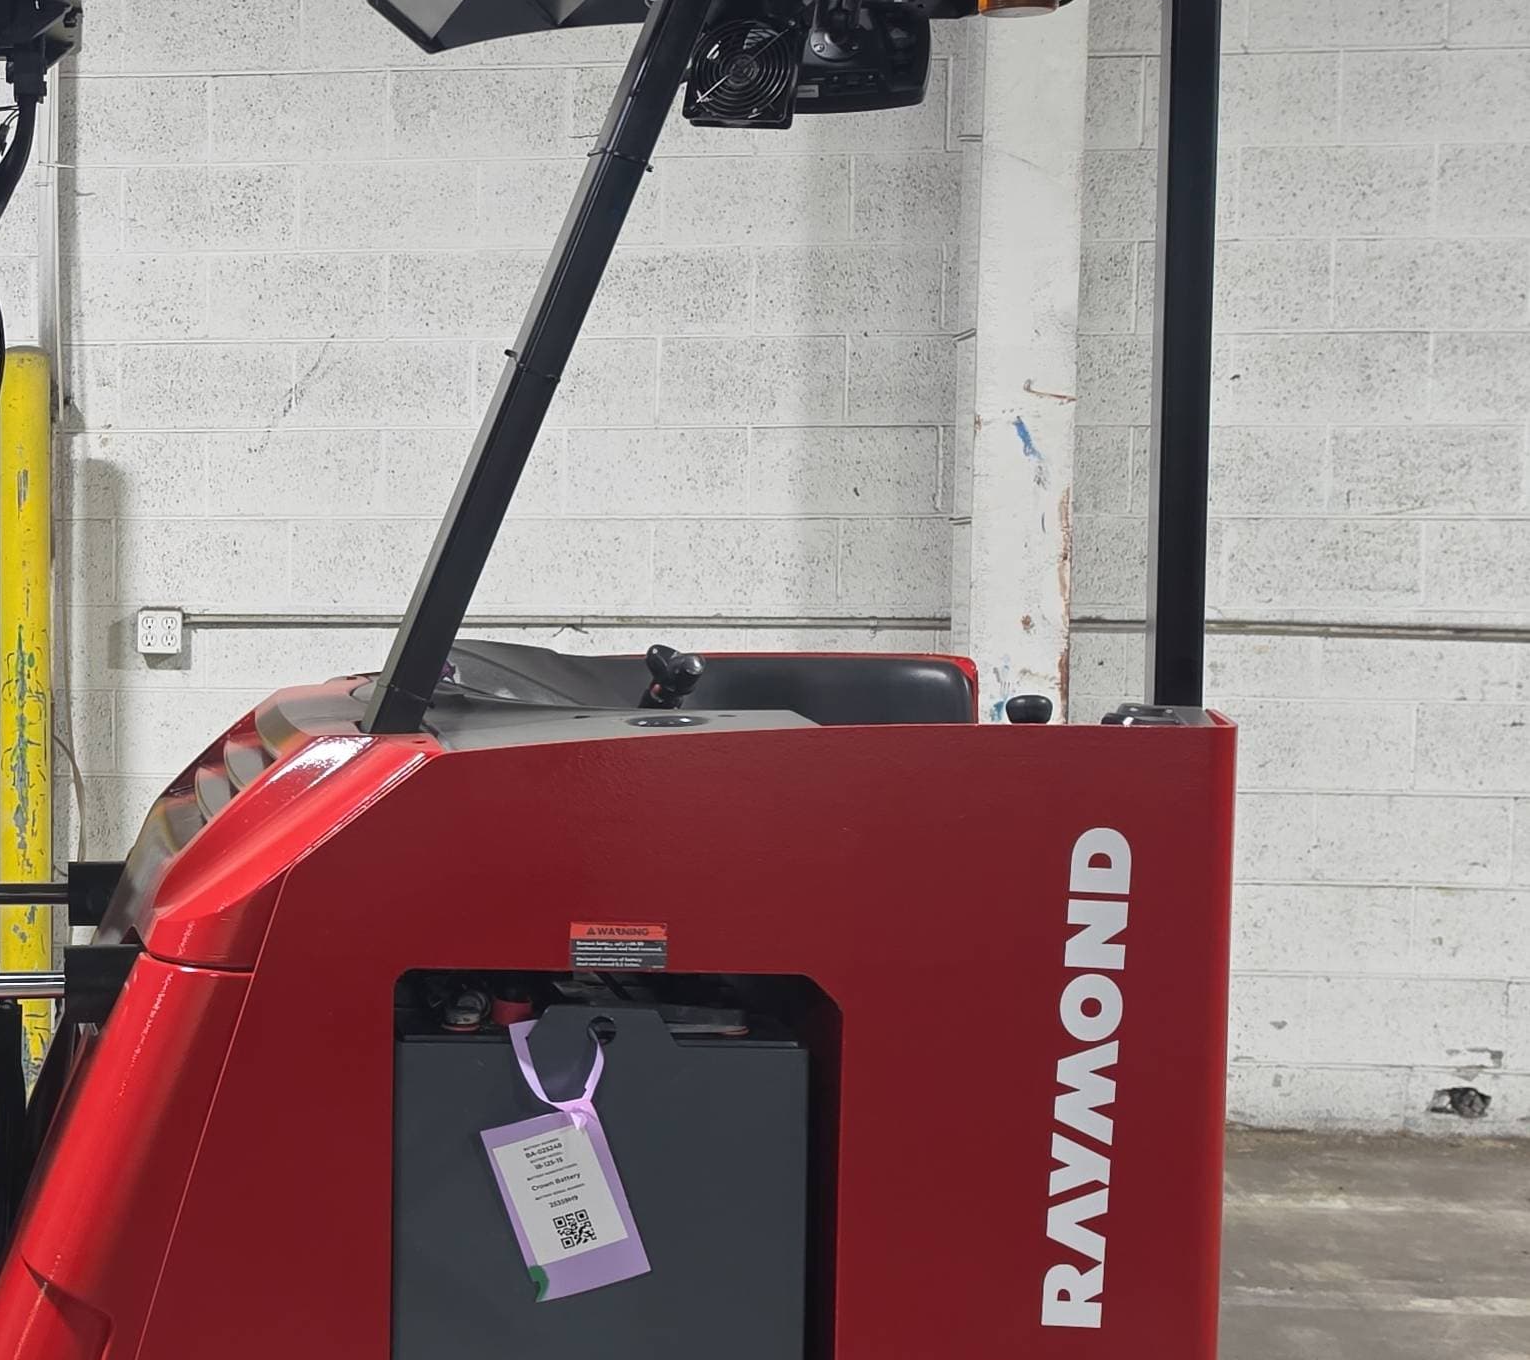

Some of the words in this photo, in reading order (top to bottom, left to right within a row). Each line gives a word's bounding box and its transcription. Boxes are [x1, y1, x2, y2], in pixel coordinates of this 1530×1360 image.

[598, 927, 649, 936] WARNING
[1041, 827, 1132, 1328] RAYMOND
[531, 1181, 554, 1191] Crown
[555, 1173, 580, 1184] Battery
